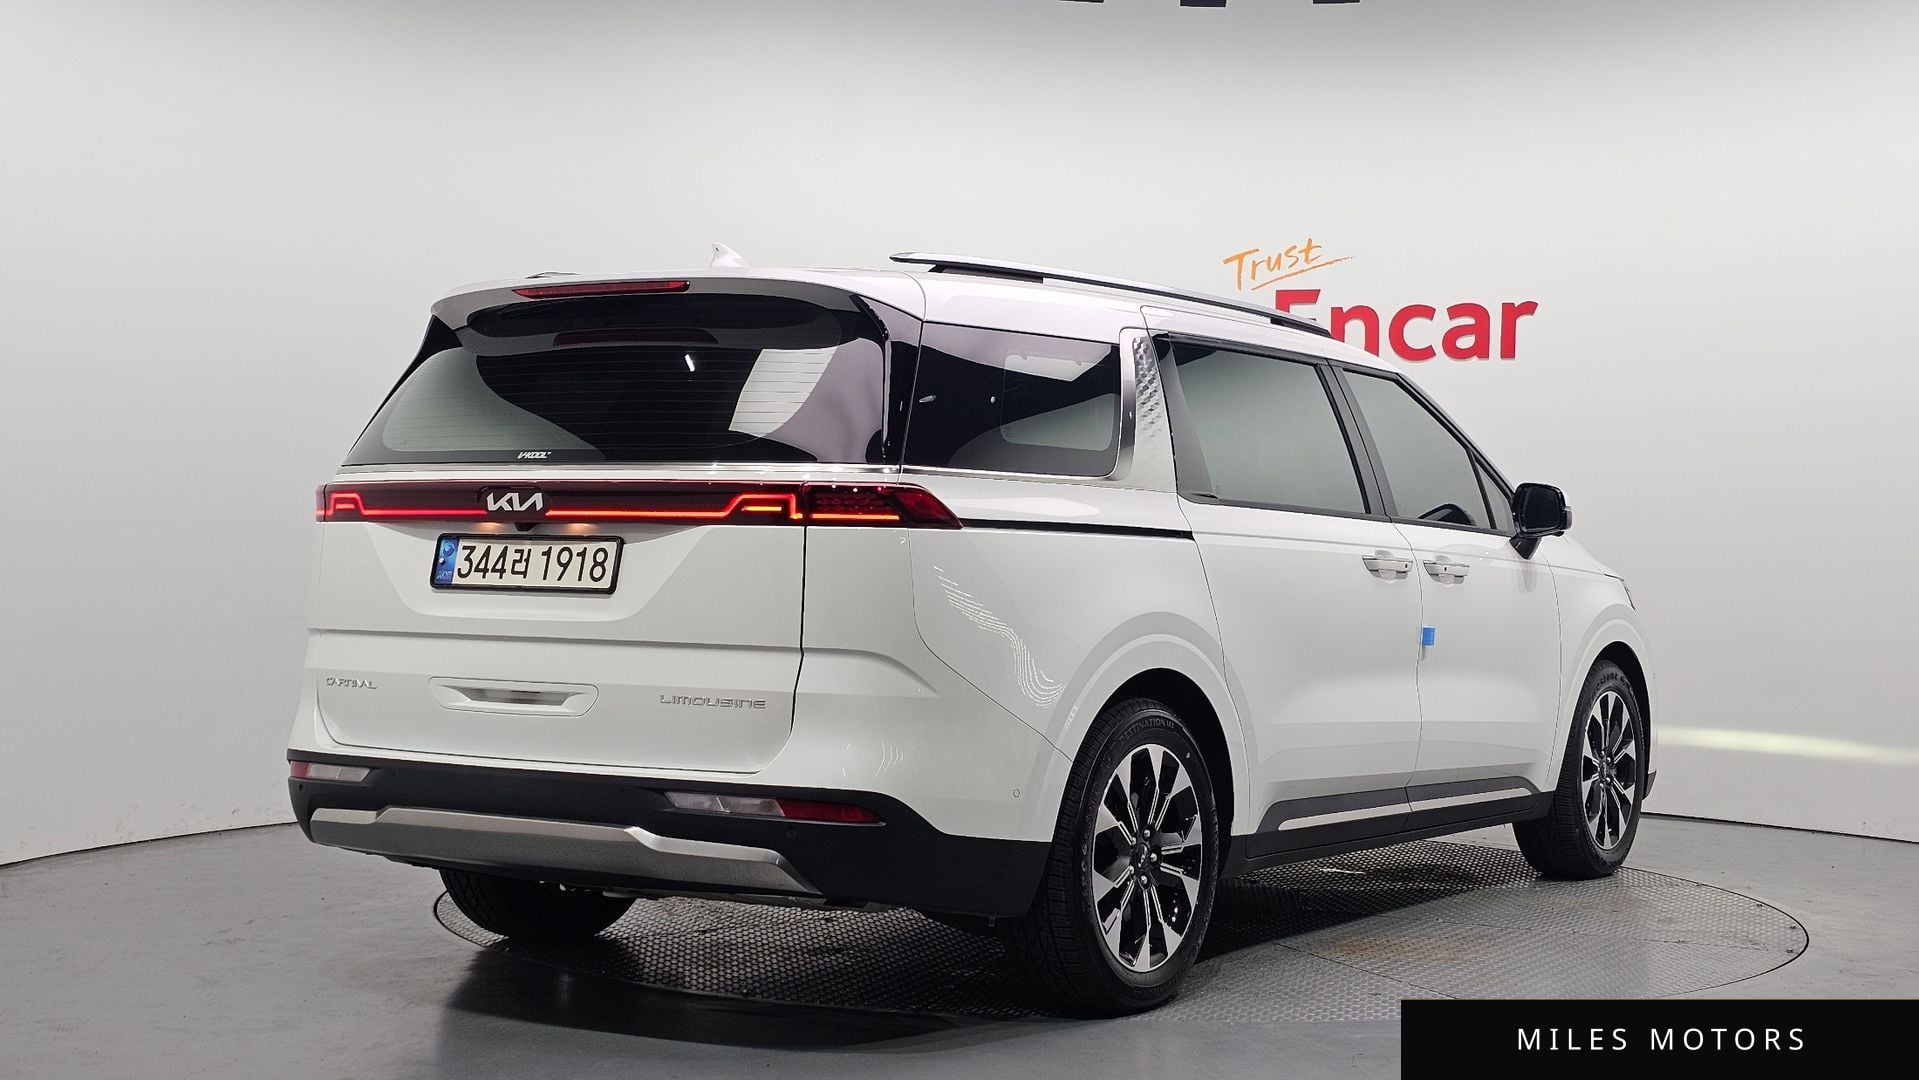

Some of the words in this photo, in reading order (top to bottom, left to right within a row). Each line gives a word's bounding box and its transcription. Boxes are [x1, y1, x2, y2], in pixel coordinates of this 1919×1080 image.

[1223, 238, 1322, 291] Trust
[486, 492, 543, 512] KIA
[457, 545, 531, 580] 344러
[541, 546, 609, 583] 1918
[660, 694, 766, 710] LIMOUSINE
